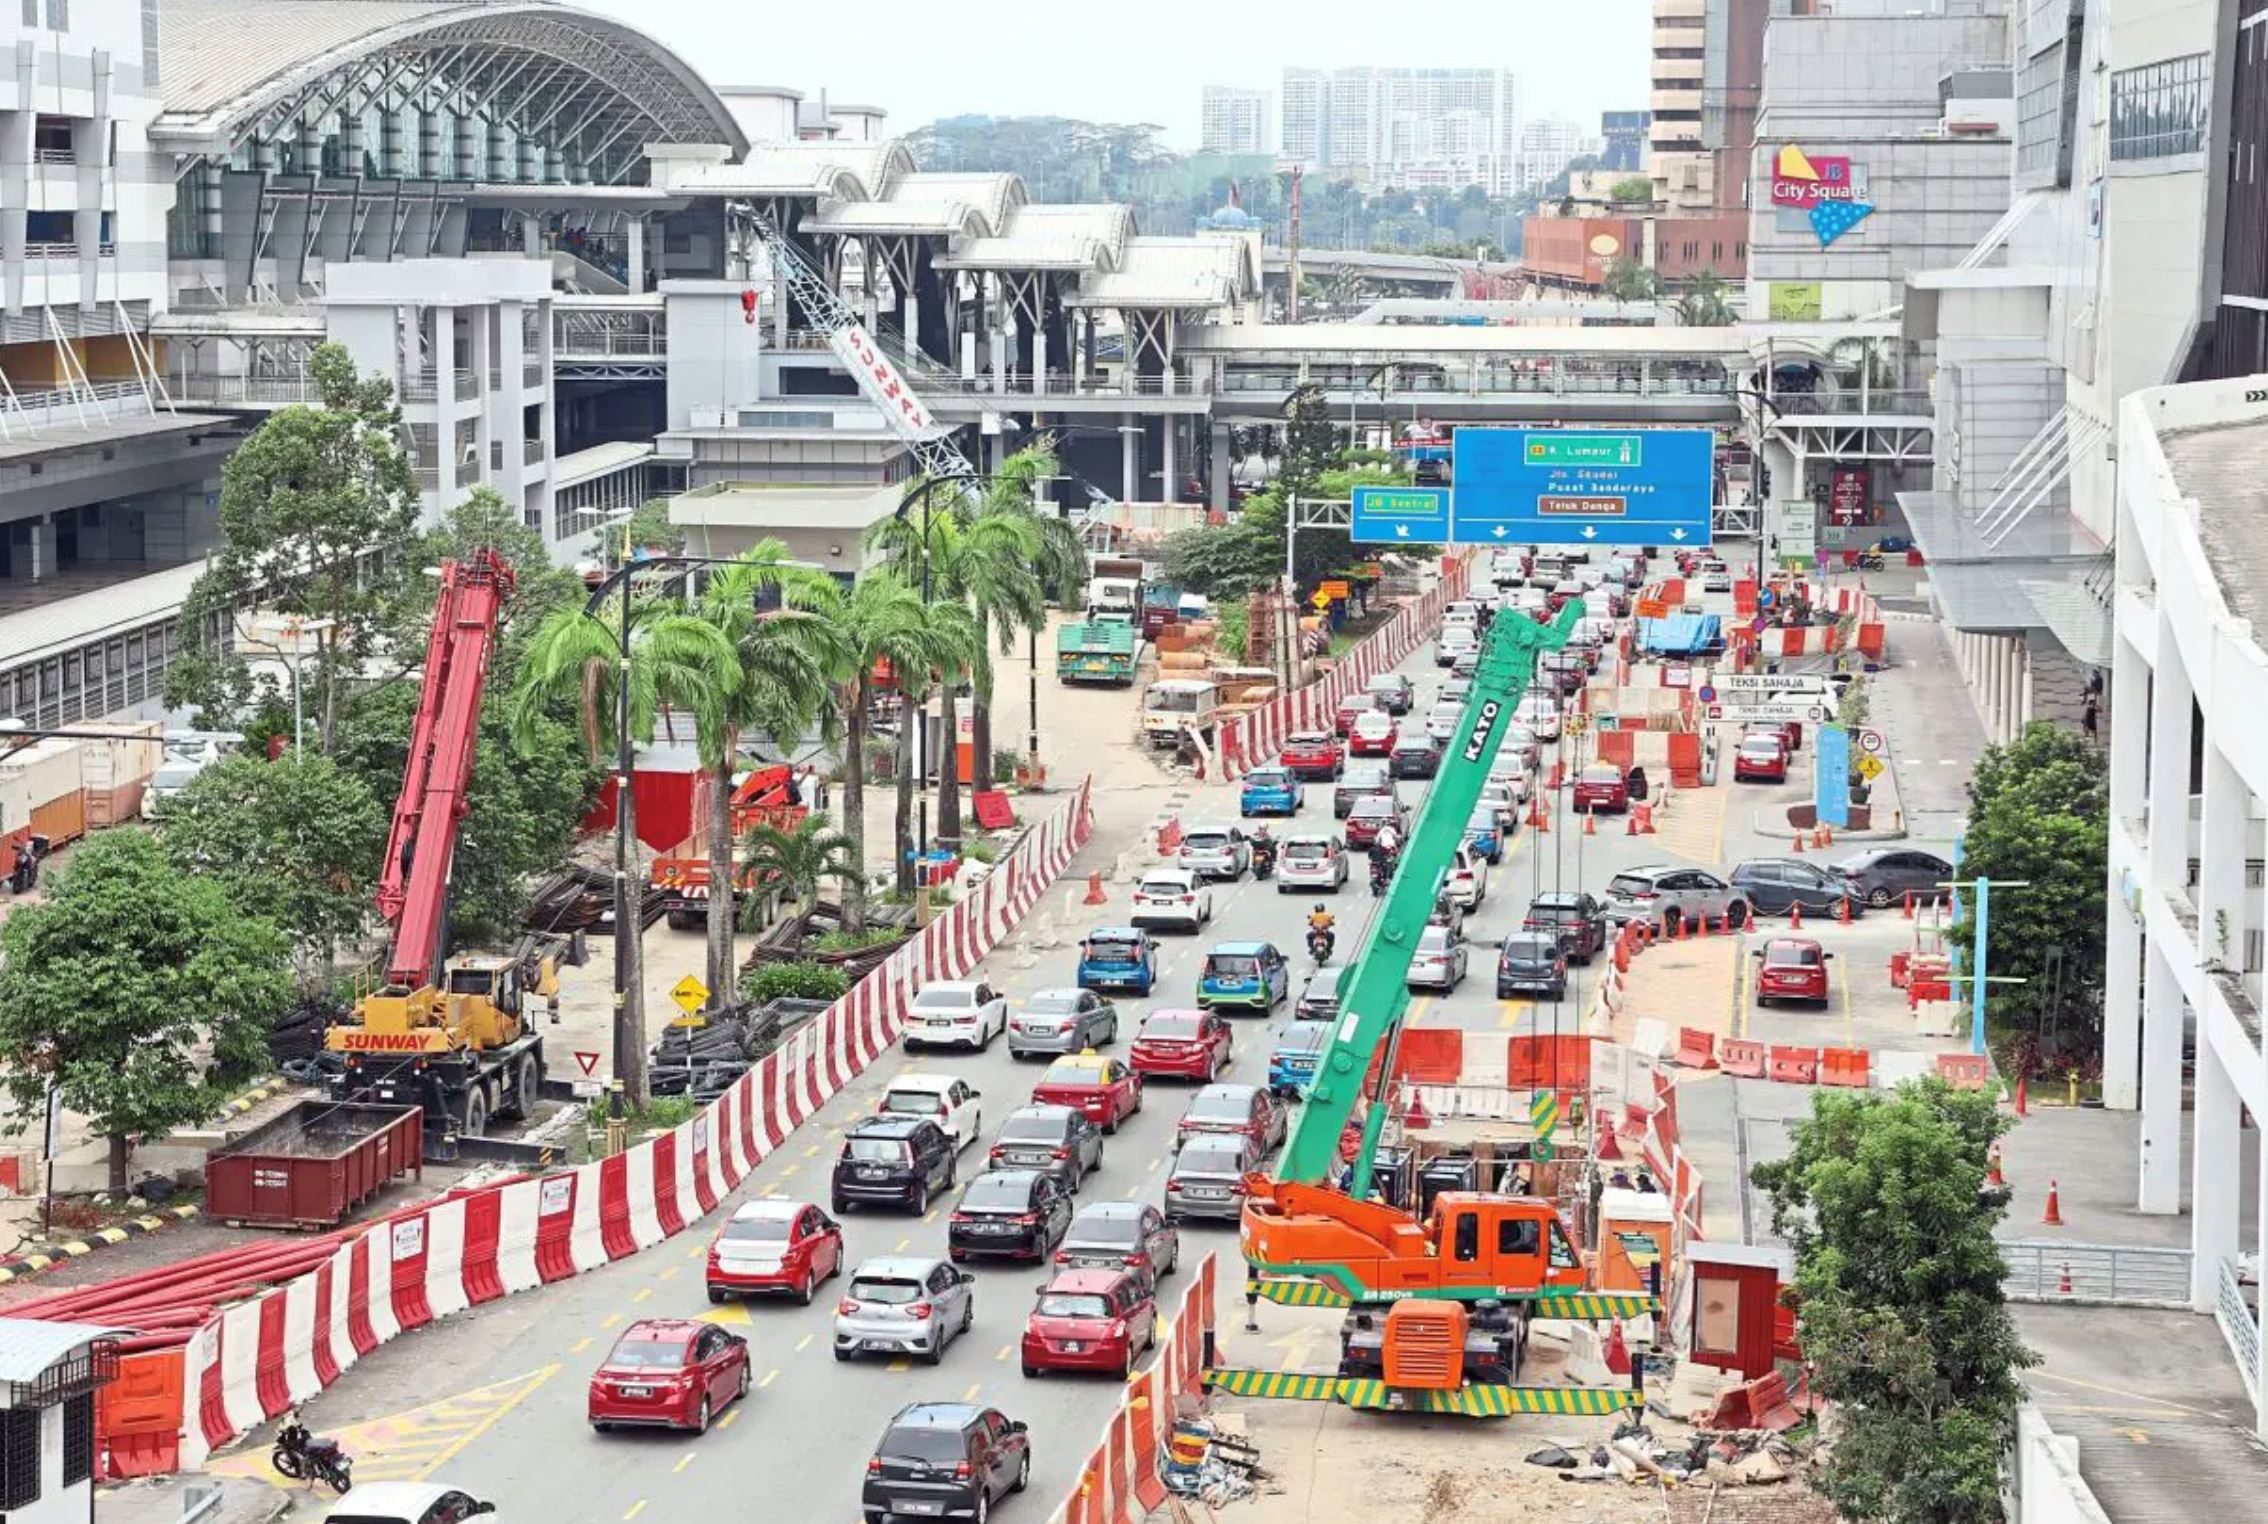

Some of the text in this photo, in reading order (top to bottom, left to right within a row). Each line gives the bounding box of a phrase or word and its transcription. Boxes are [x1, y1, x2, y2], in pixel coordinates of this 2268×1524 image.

[1774, 183, 1868, 201] City Square
[850, 332, 922, 428] SUNWAY
[1548, 501, 1578, 511] Teluk
[1729, 677, 1804, 689] TEKSI SAHAJA
[1465, 702, 1498, 761] KATO
[344, 1034, 431, 1050] SUNWAY
